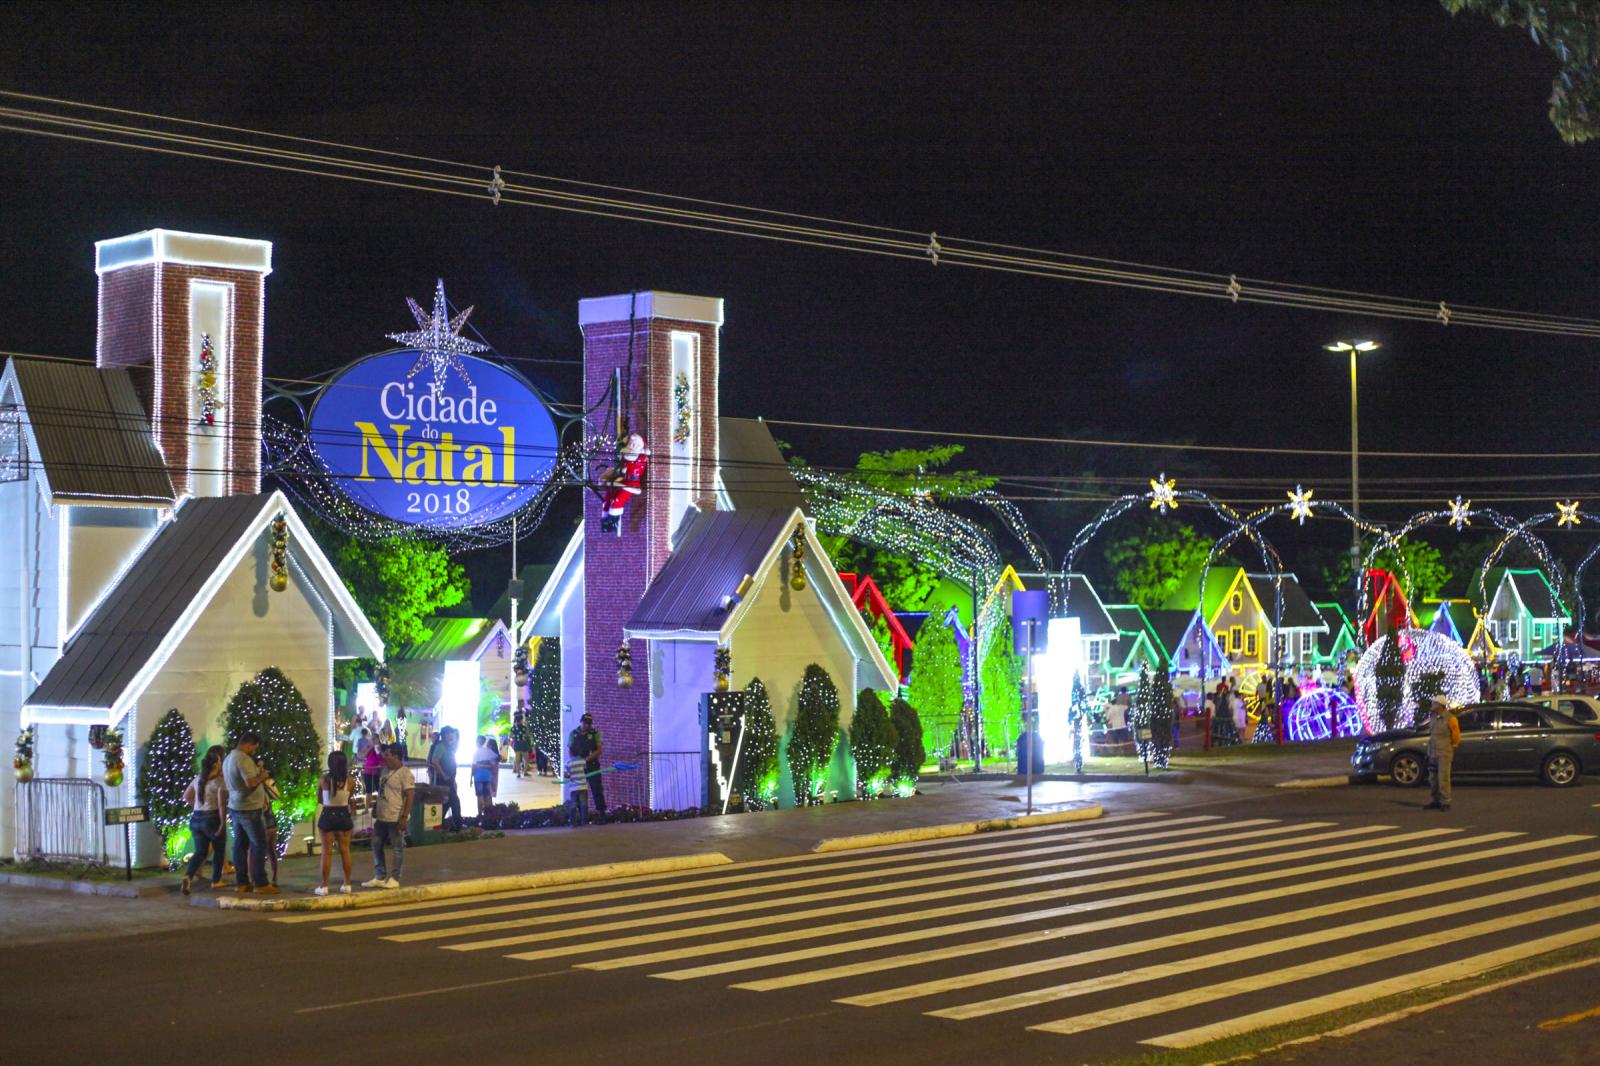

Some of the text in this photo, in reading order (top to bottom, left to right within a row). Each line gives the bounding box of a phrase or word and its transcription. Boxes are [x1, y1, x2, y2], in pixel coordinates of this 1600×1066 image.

[380, 381, 497, 425] Cidade
[421, 423, 438, 439] do
[354, 421, 519, 488] Natal
[407, 488, 470, 514] 2018
